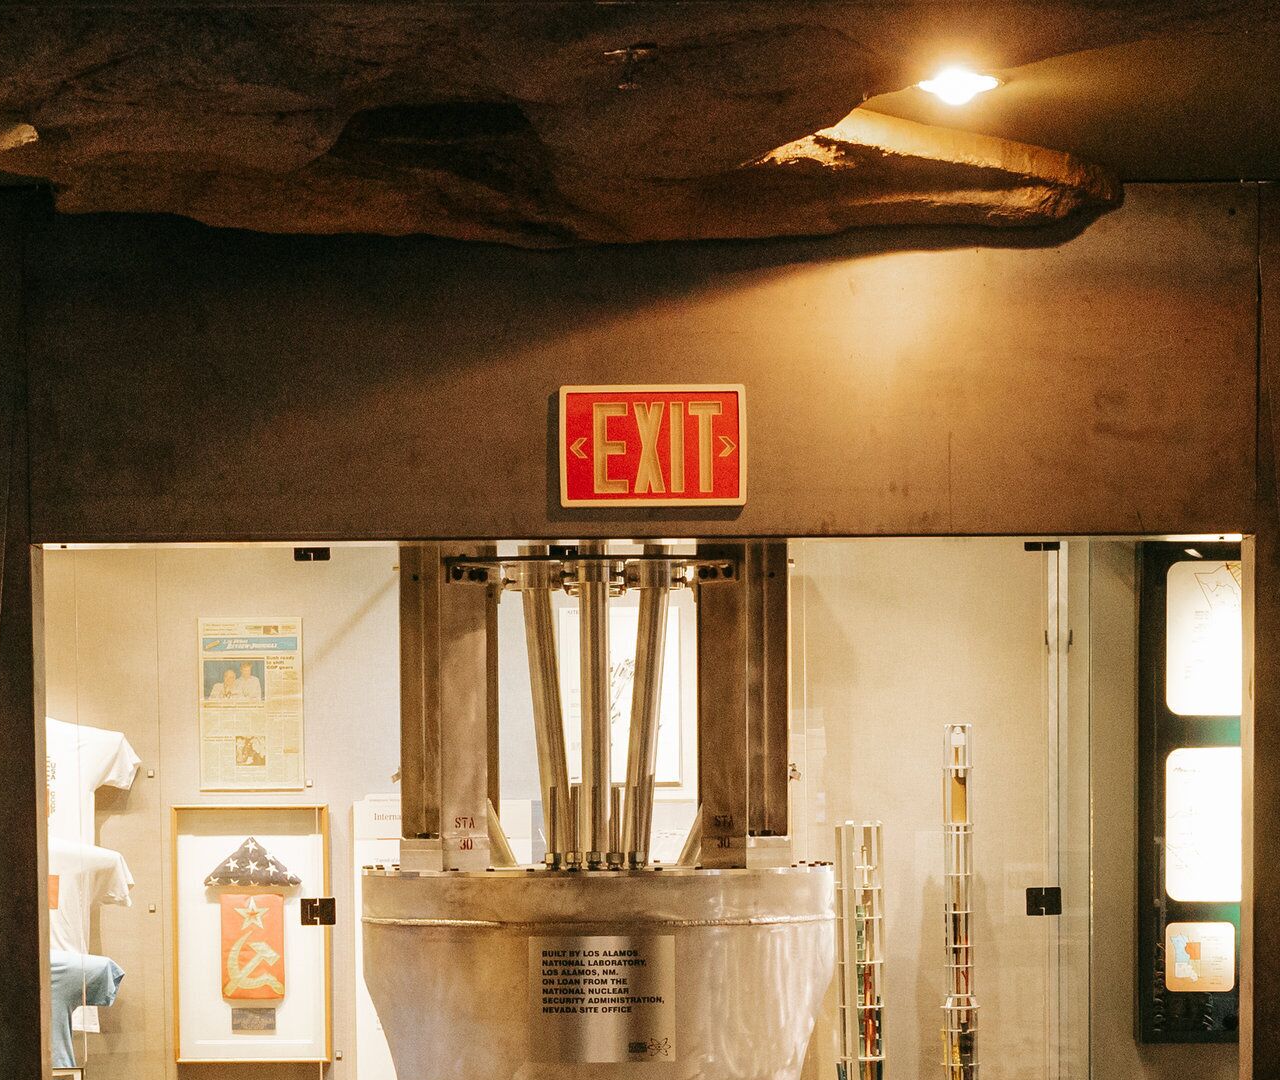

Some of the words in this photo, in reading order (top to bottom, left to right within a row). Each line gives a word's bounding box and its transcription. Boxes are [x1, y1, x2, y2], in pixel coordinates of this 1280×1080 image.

[592, 401, 723, 494] EXIT
[455, 817, 475, 829] STA
[714, 815, 734, 828] STA
[459, 838, 473, 850] 30
[717, 836, 731, 848] 30
[561, 969, 600, 977] ALAMOS,
[588, 996, 665, 1004] ADMINISTRATION,
